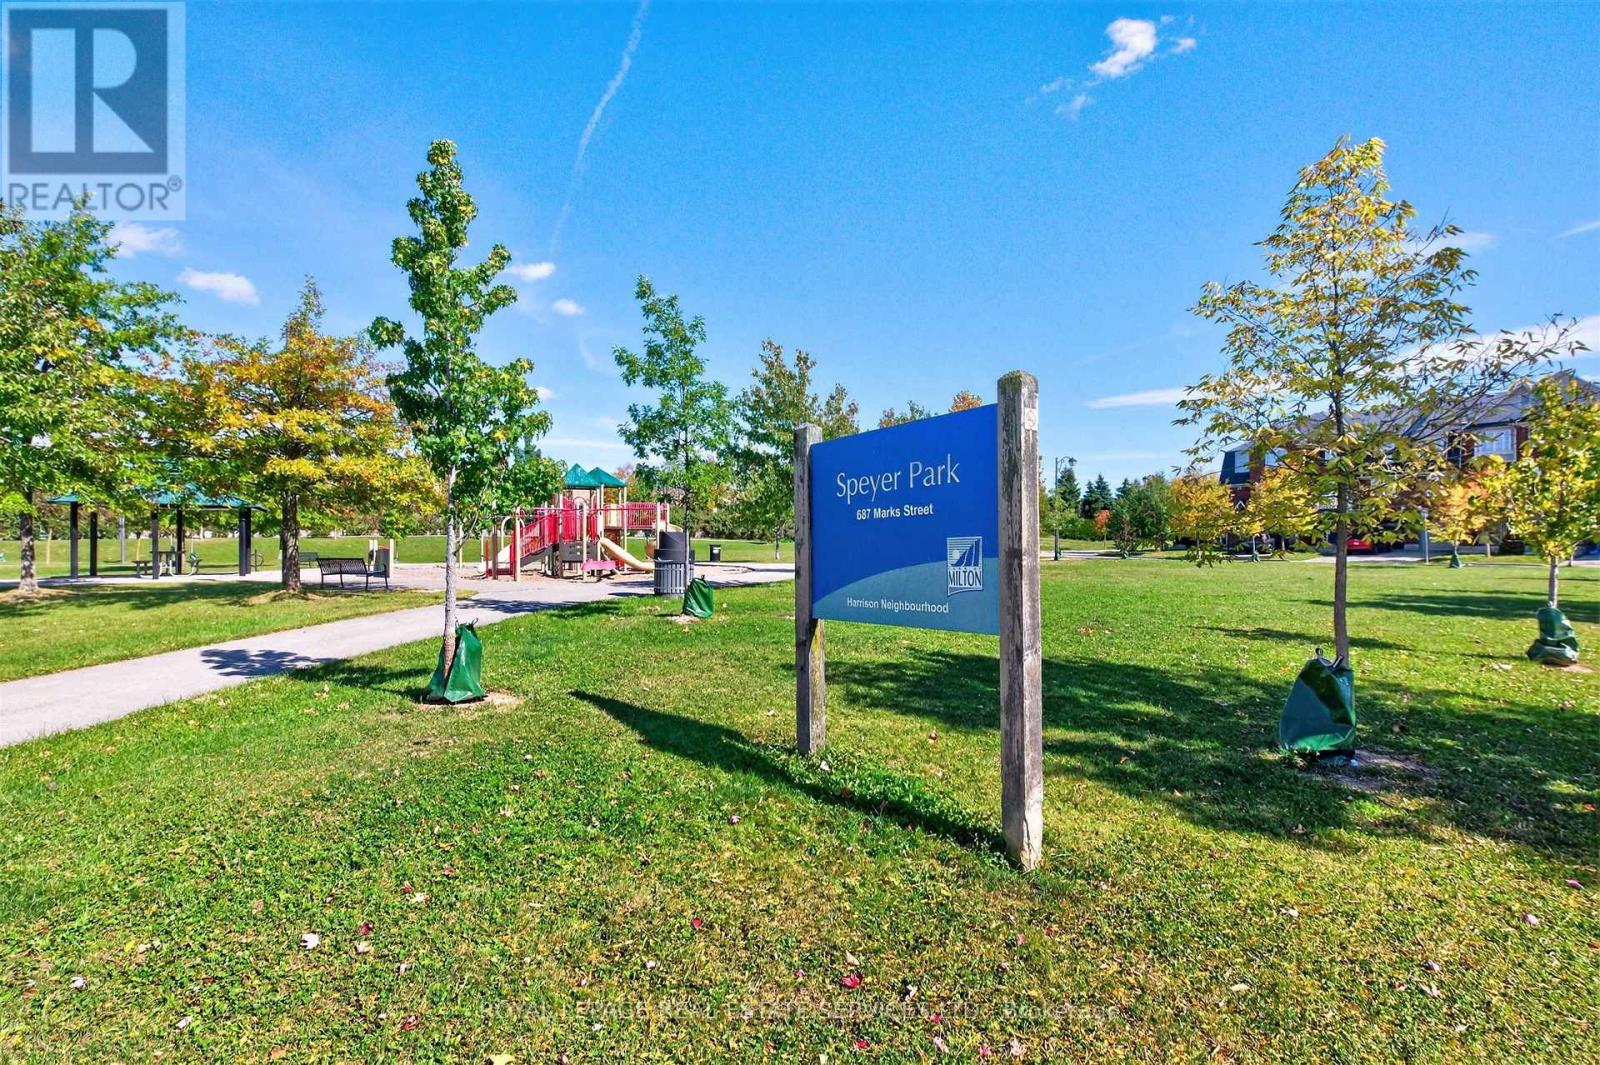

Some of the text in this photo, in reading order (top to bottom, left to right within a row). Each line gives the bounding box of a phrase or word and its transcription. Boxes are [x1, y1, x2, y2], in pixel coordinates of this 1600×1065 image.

[836, 453, 961, 505] Speyer Park
[856, 503, 934, 521] 687 Marks Street
[948, 569, 982, 587] MILTON
[847, 597, 949, 614] Harrison Neighbourhood
